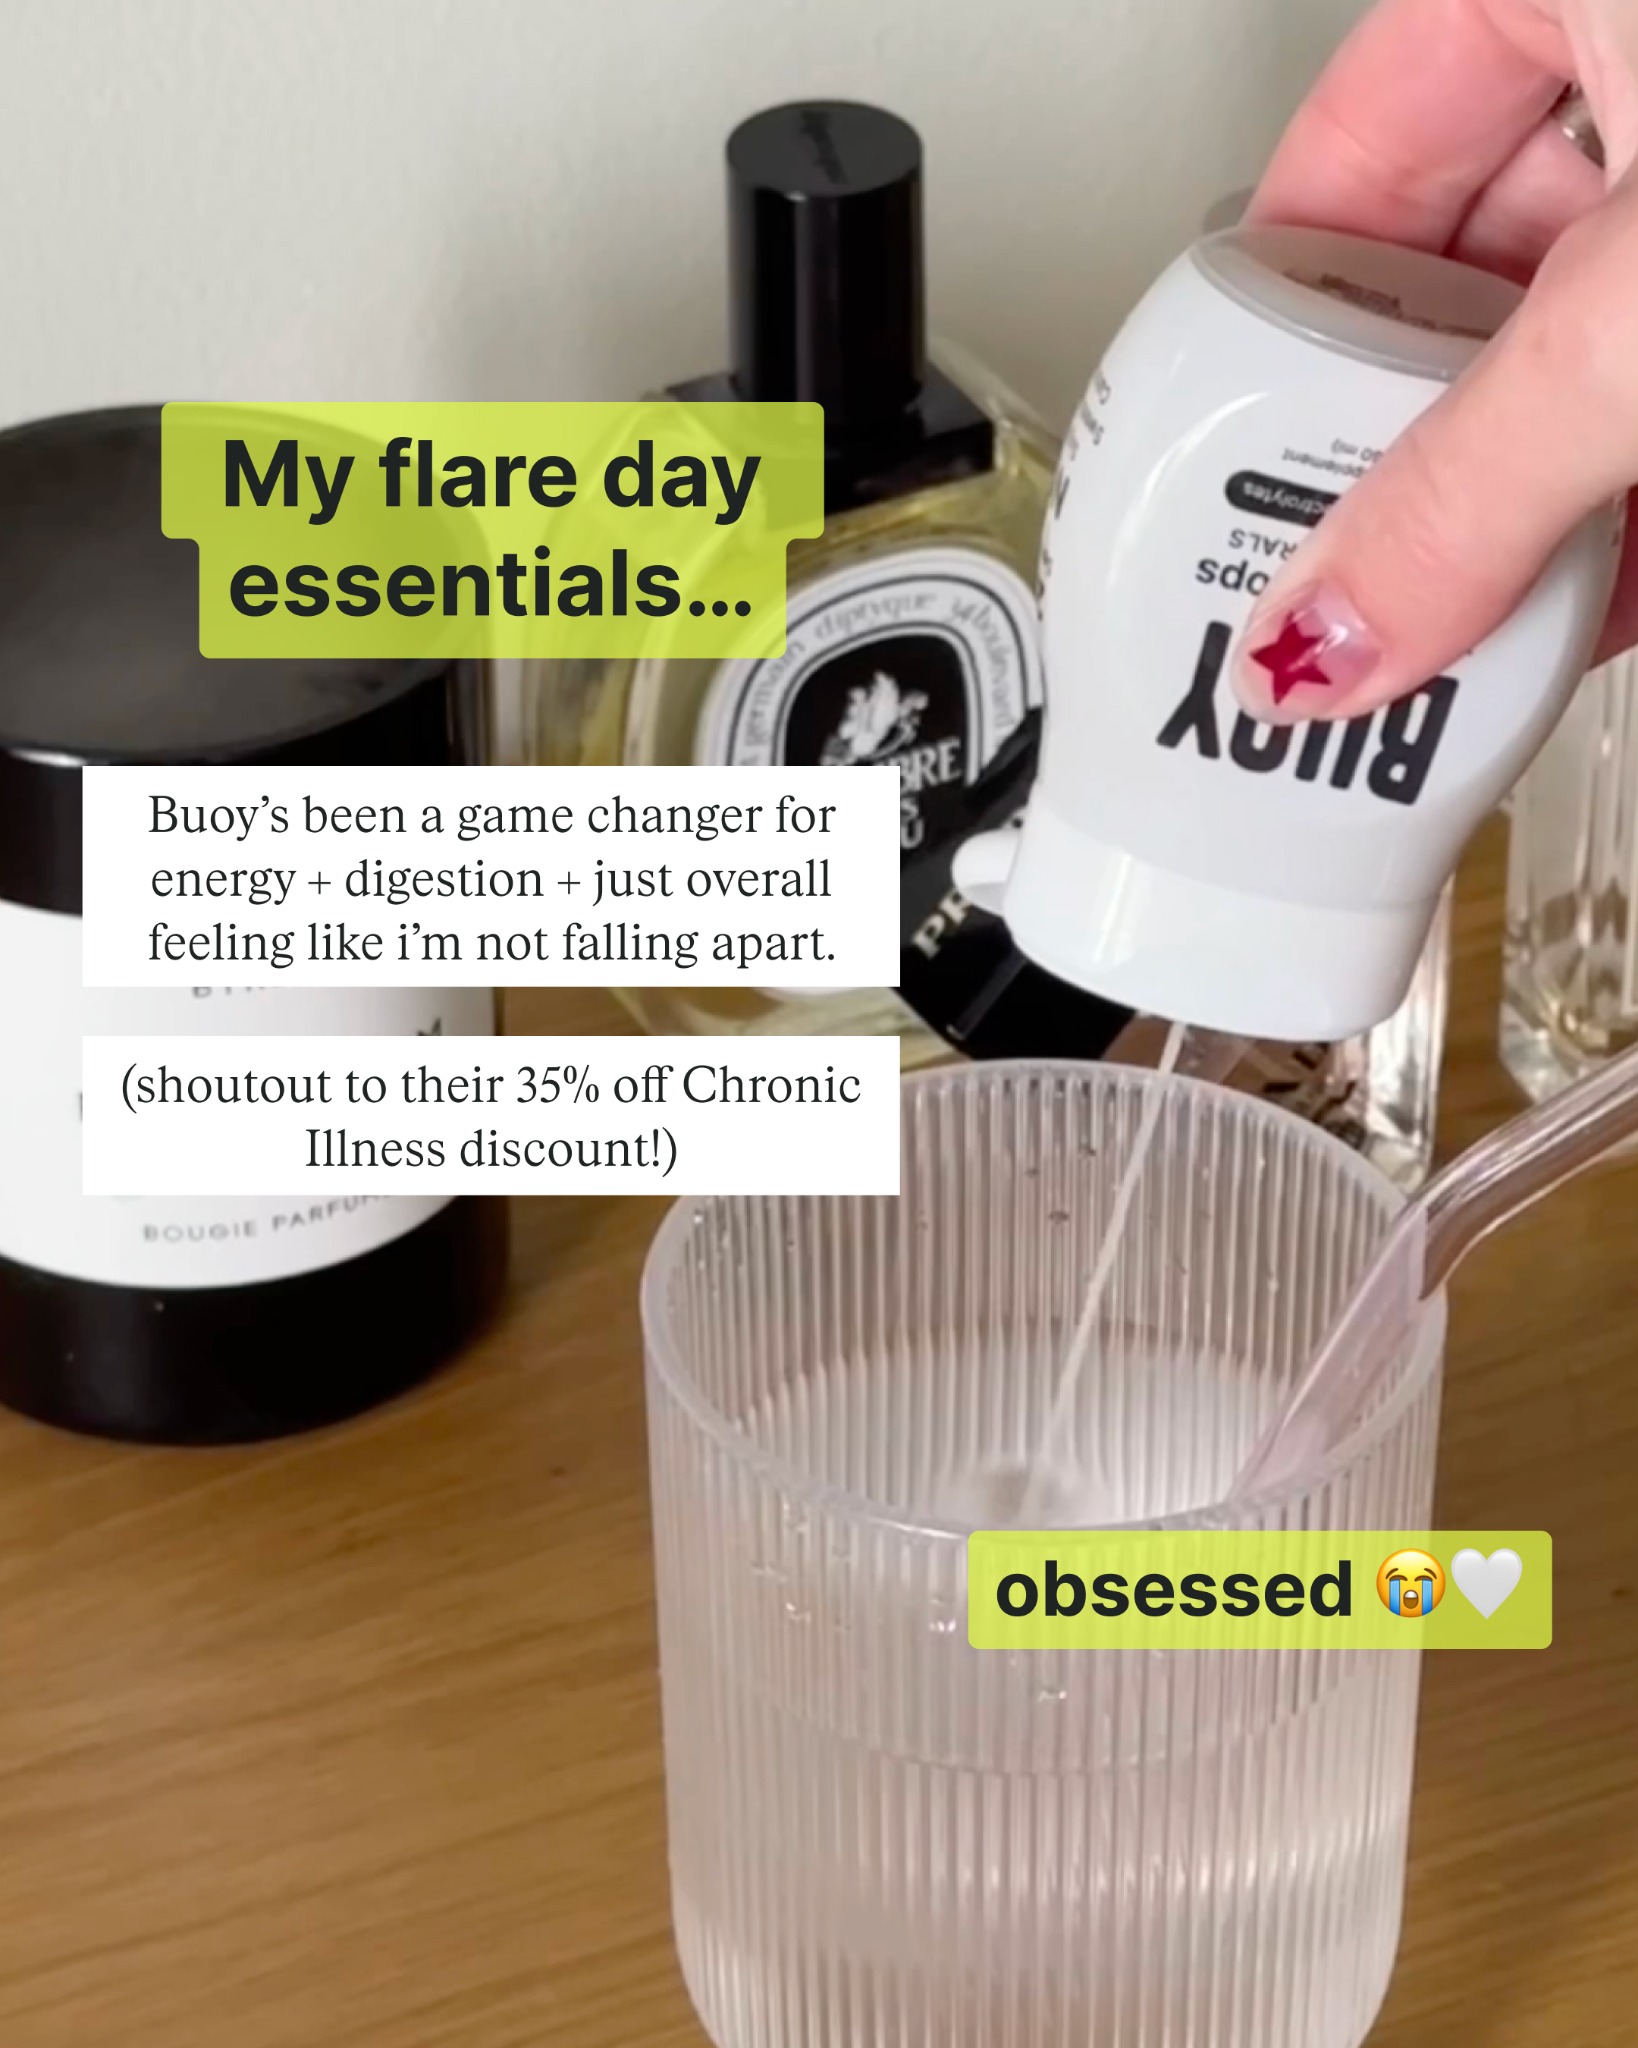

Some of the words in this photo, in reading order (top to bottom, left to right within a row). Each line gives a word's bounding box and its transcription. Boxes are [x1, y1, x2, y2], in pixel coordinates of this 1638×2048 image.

[1282, 448, 1366, 480] pplement
[1243, 480, 1325, 515] ctrolytes
[1227, 528, 1298, 562] RALS
[1194, 557, 1271, 598] ops
[890, 737, 963, 793] BRE
[143, 1220, 259, 1244] BOUGIE
[272, 1195, 390, 1231] PARFU
